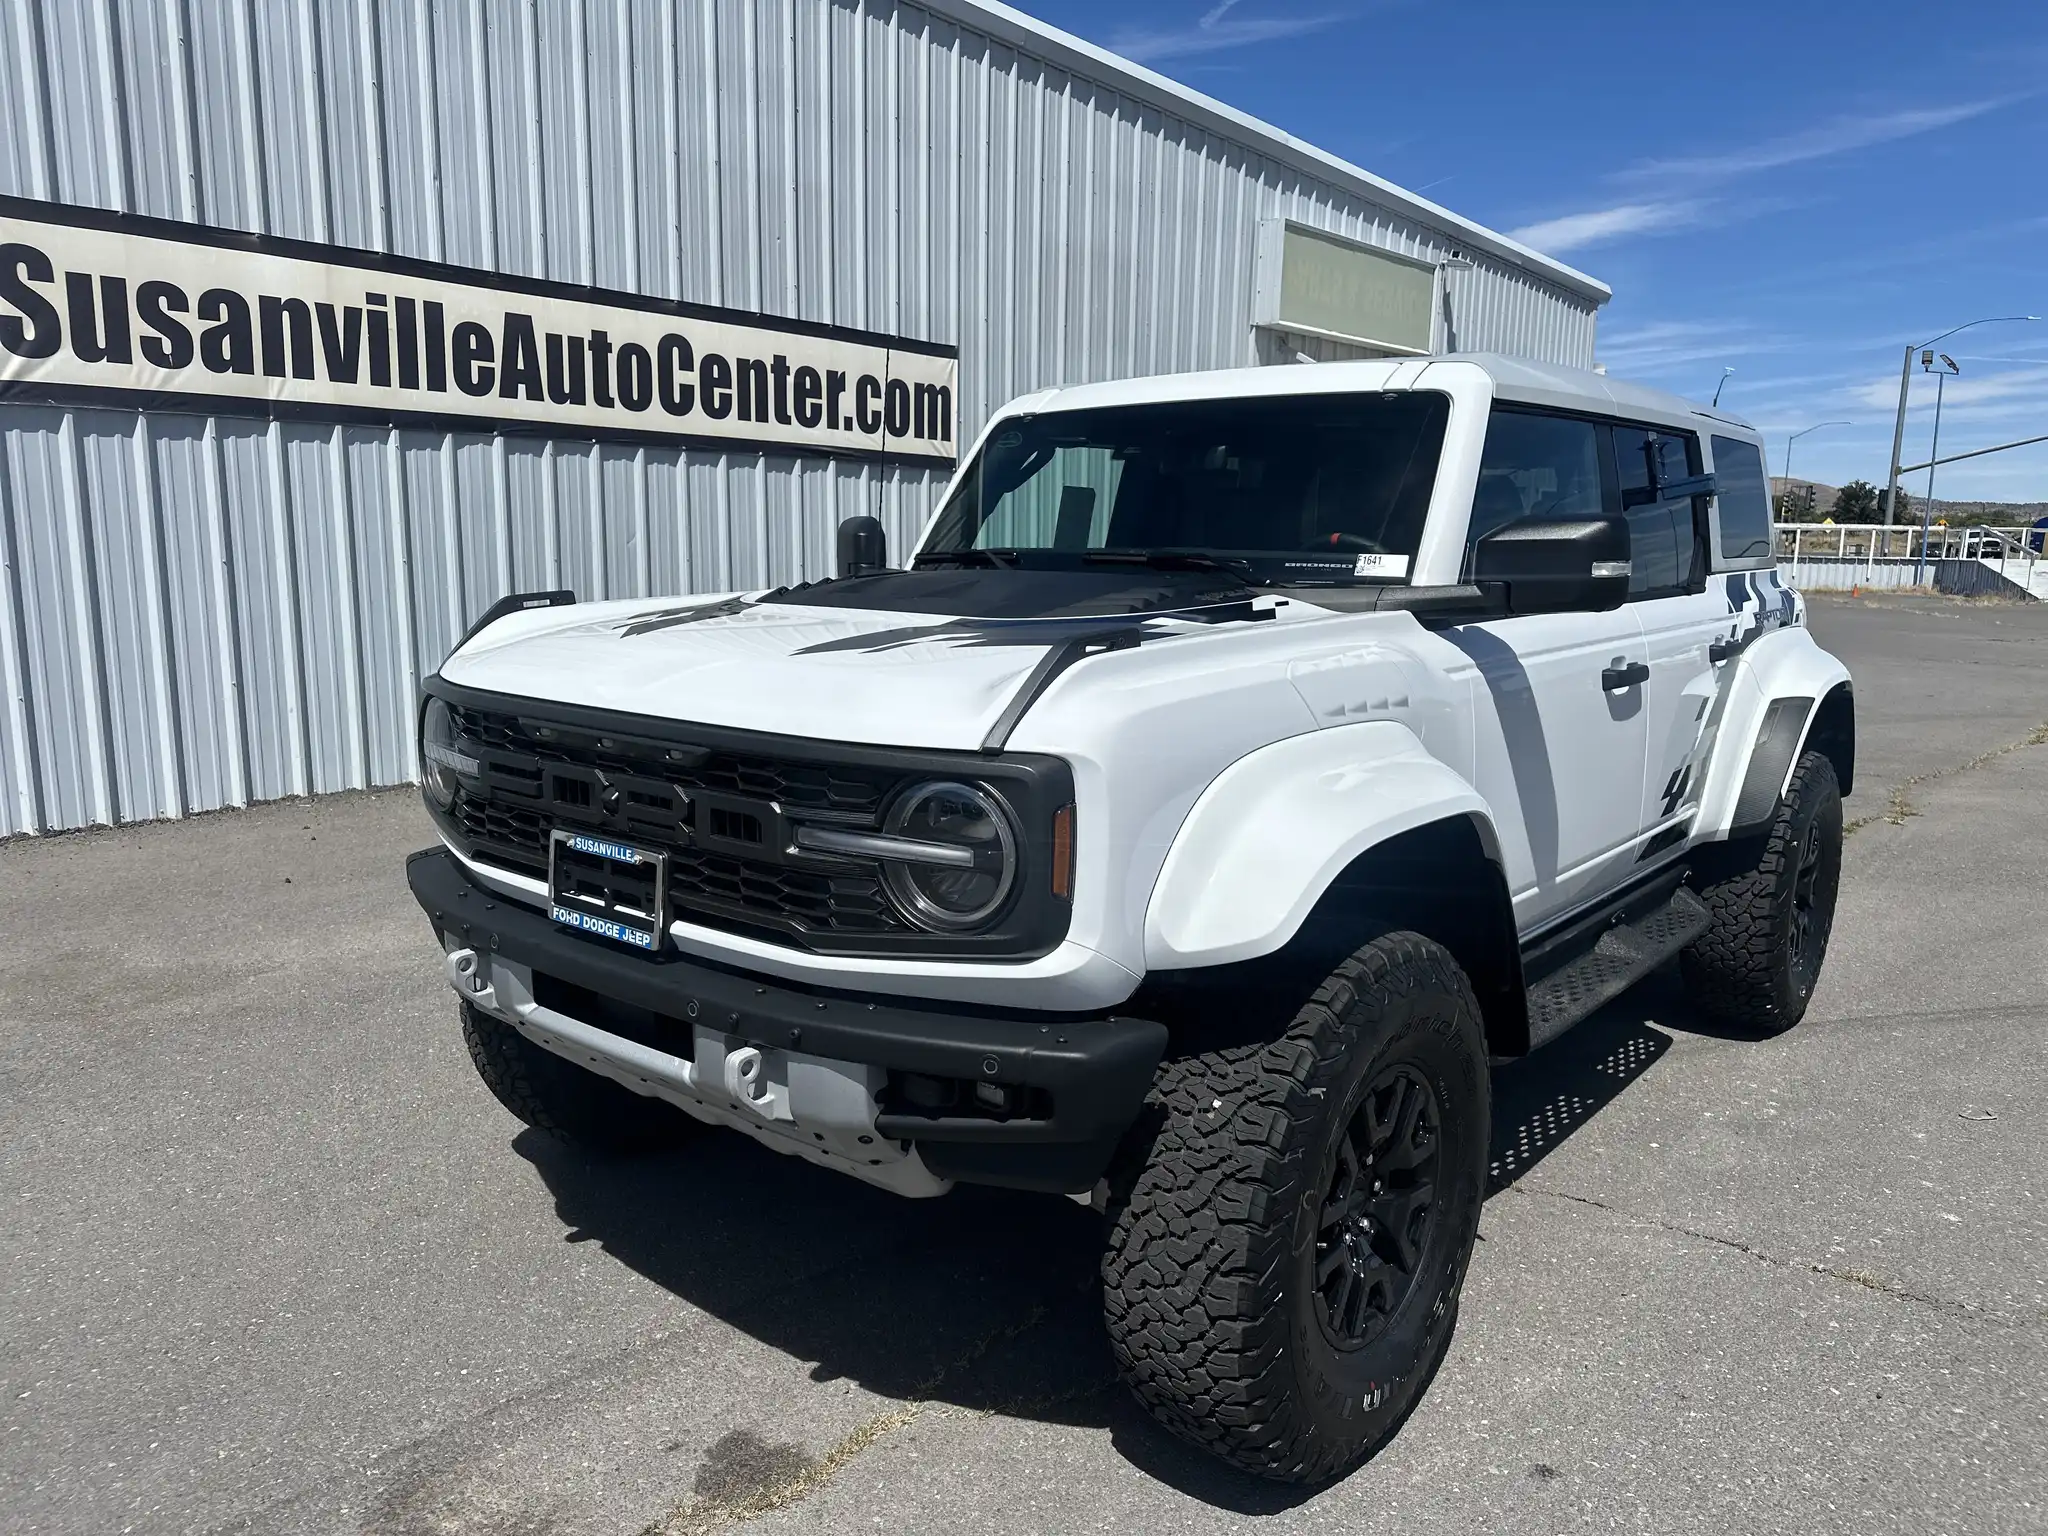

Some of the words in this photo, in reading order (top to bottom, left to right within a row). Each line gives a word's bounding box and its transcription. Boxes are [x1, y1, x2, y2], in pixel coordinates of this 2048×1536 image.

[0, 243, 952, 442] SusanvilleAutoCenter.com
[1356, 555, 1382, 566] F1641
[479, 749, 785, 862] FORD
[575, 837, 632, 861] SUSANVILLE
[553, 906, 580, 924] FORD
[583, 916, 620, 938] DODGE
[622, 929, 651, 946] JEEP
